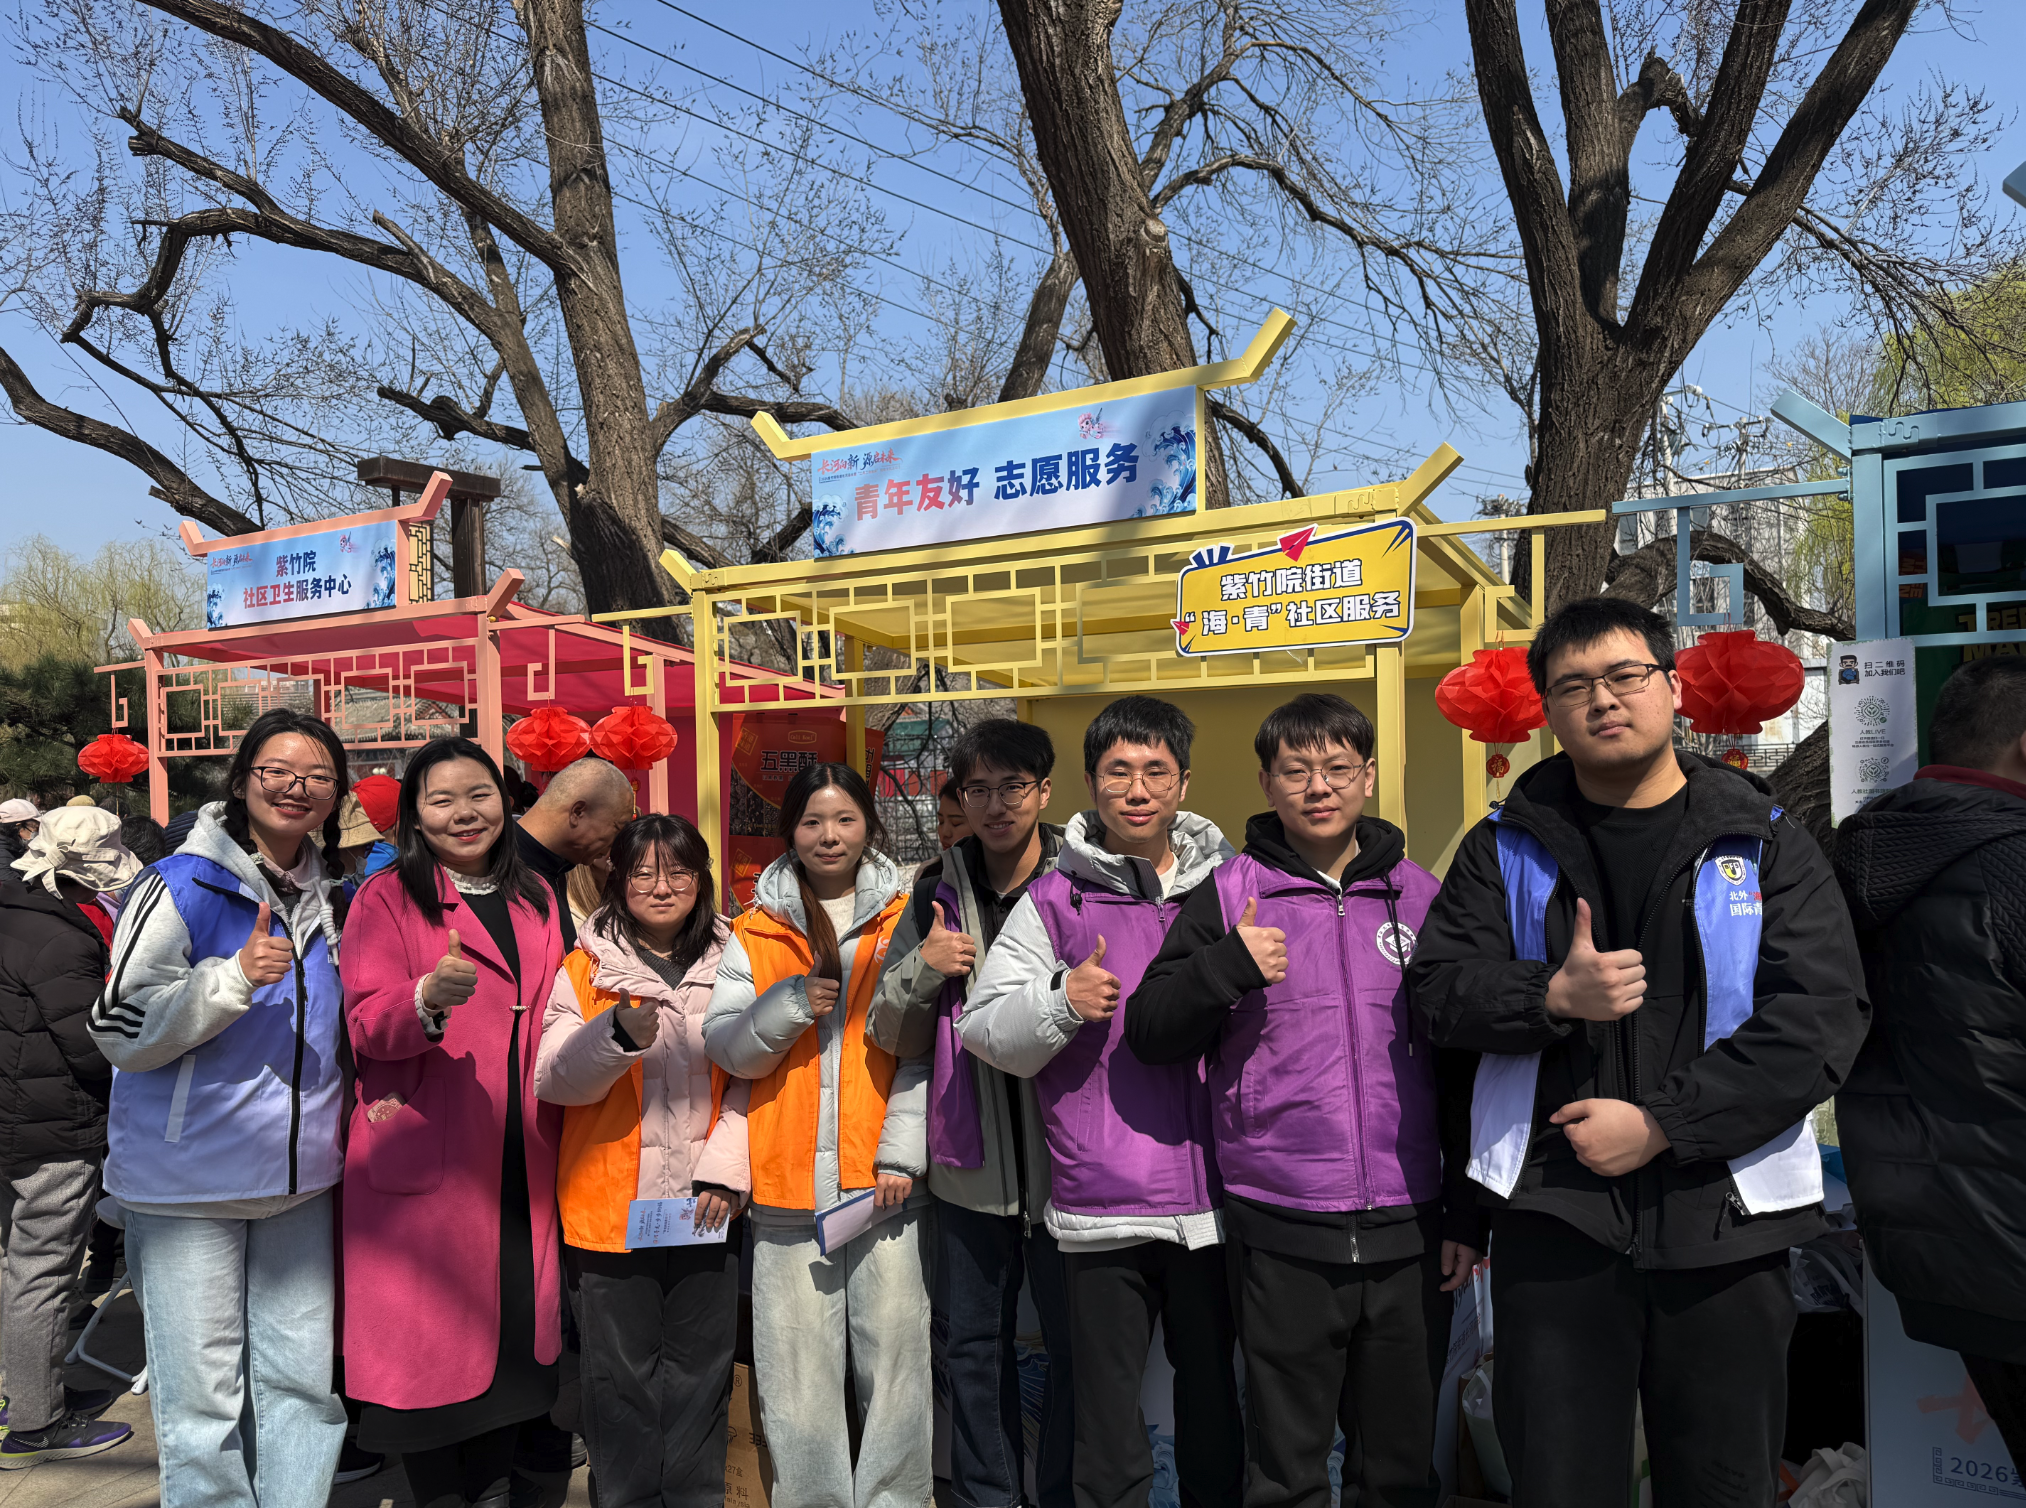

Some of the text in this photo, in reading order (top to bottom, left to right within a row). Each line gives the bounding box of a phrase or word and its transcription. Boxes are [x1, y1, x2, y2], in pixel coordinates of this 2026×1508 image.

[854, 443, 1140, 520] 青年友好 志愿服务
[275, 550, 317, 578] 紫竹院
[243, 574, 352, 609] 社区卫生服务中心
[1220, 558, 1363, 601] 紫竹院街道
[1864, 660, 1906, 670] 扫二维码
[1864, 668, 1906, 677] 加入我们吧
[760, 750, 818, 772] 五黑酥
